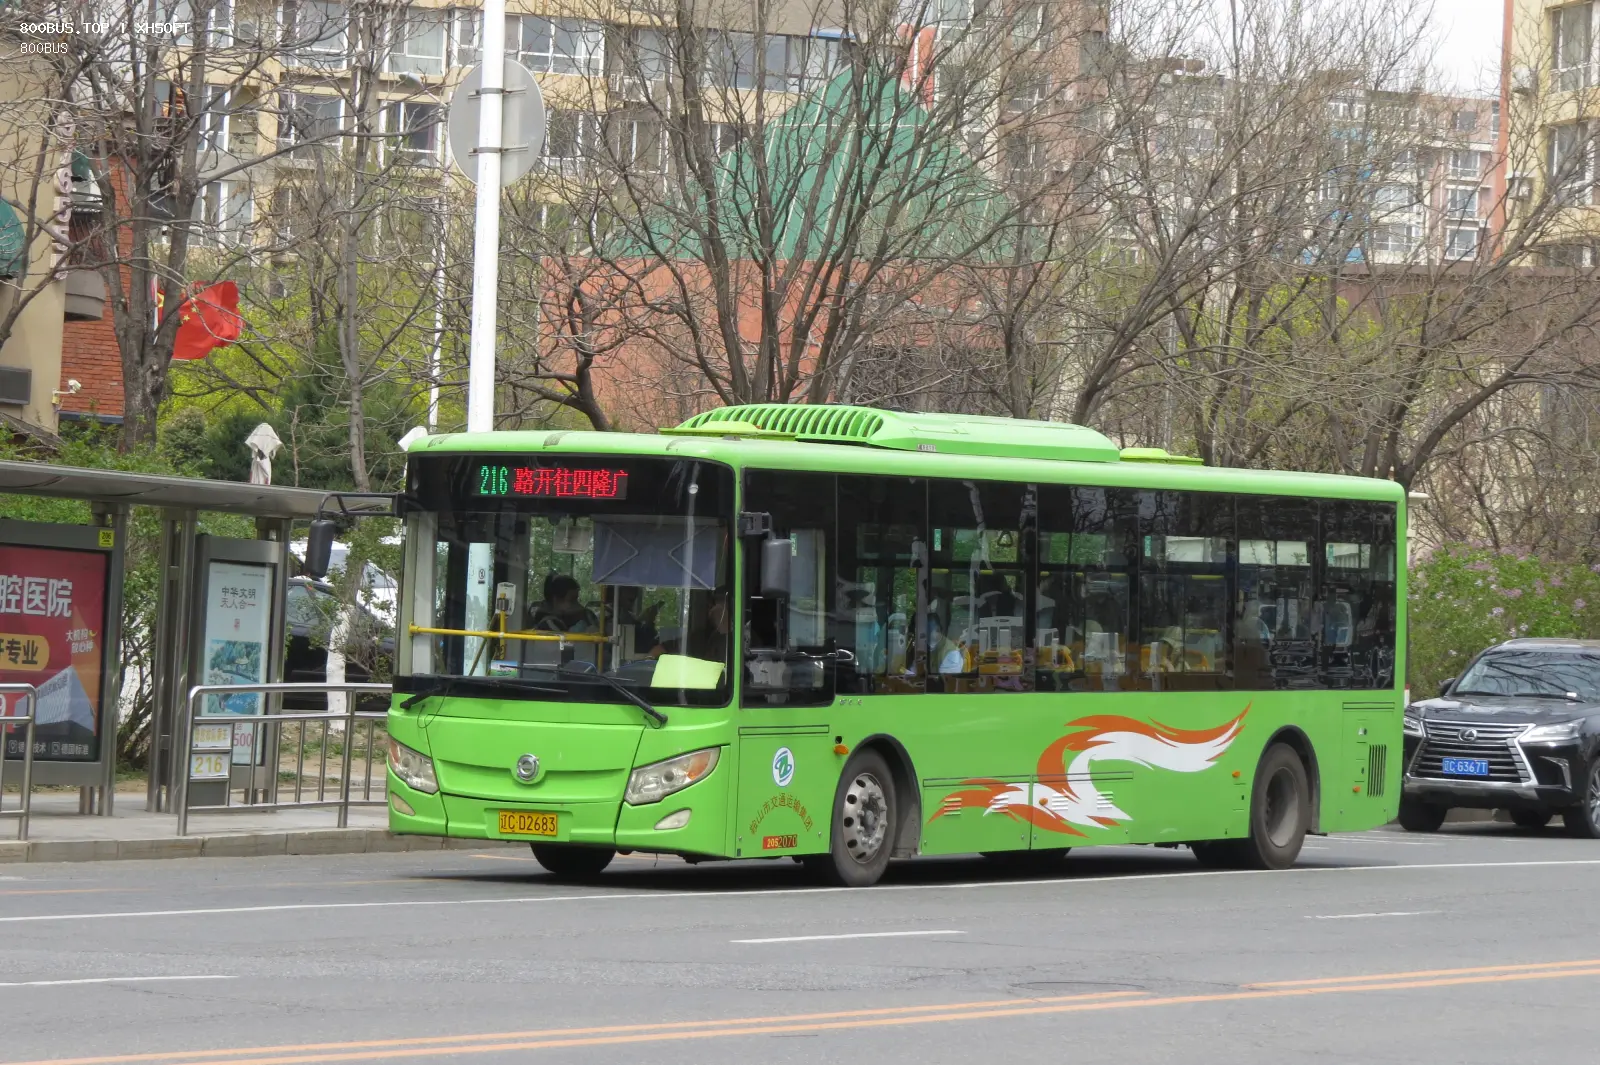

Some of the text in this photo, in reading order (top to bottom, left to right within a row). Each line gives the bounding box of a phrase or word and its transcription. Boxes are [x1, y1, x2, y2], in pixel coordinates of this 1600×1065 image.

[480, 465, 508, 495] 216
[0, 574, 73, 617] 腔医院
[221, 586, 256, 599] 中华文明
[220, 597, 256, 610] 天人合一
[194, 755, 223, 774] 216
